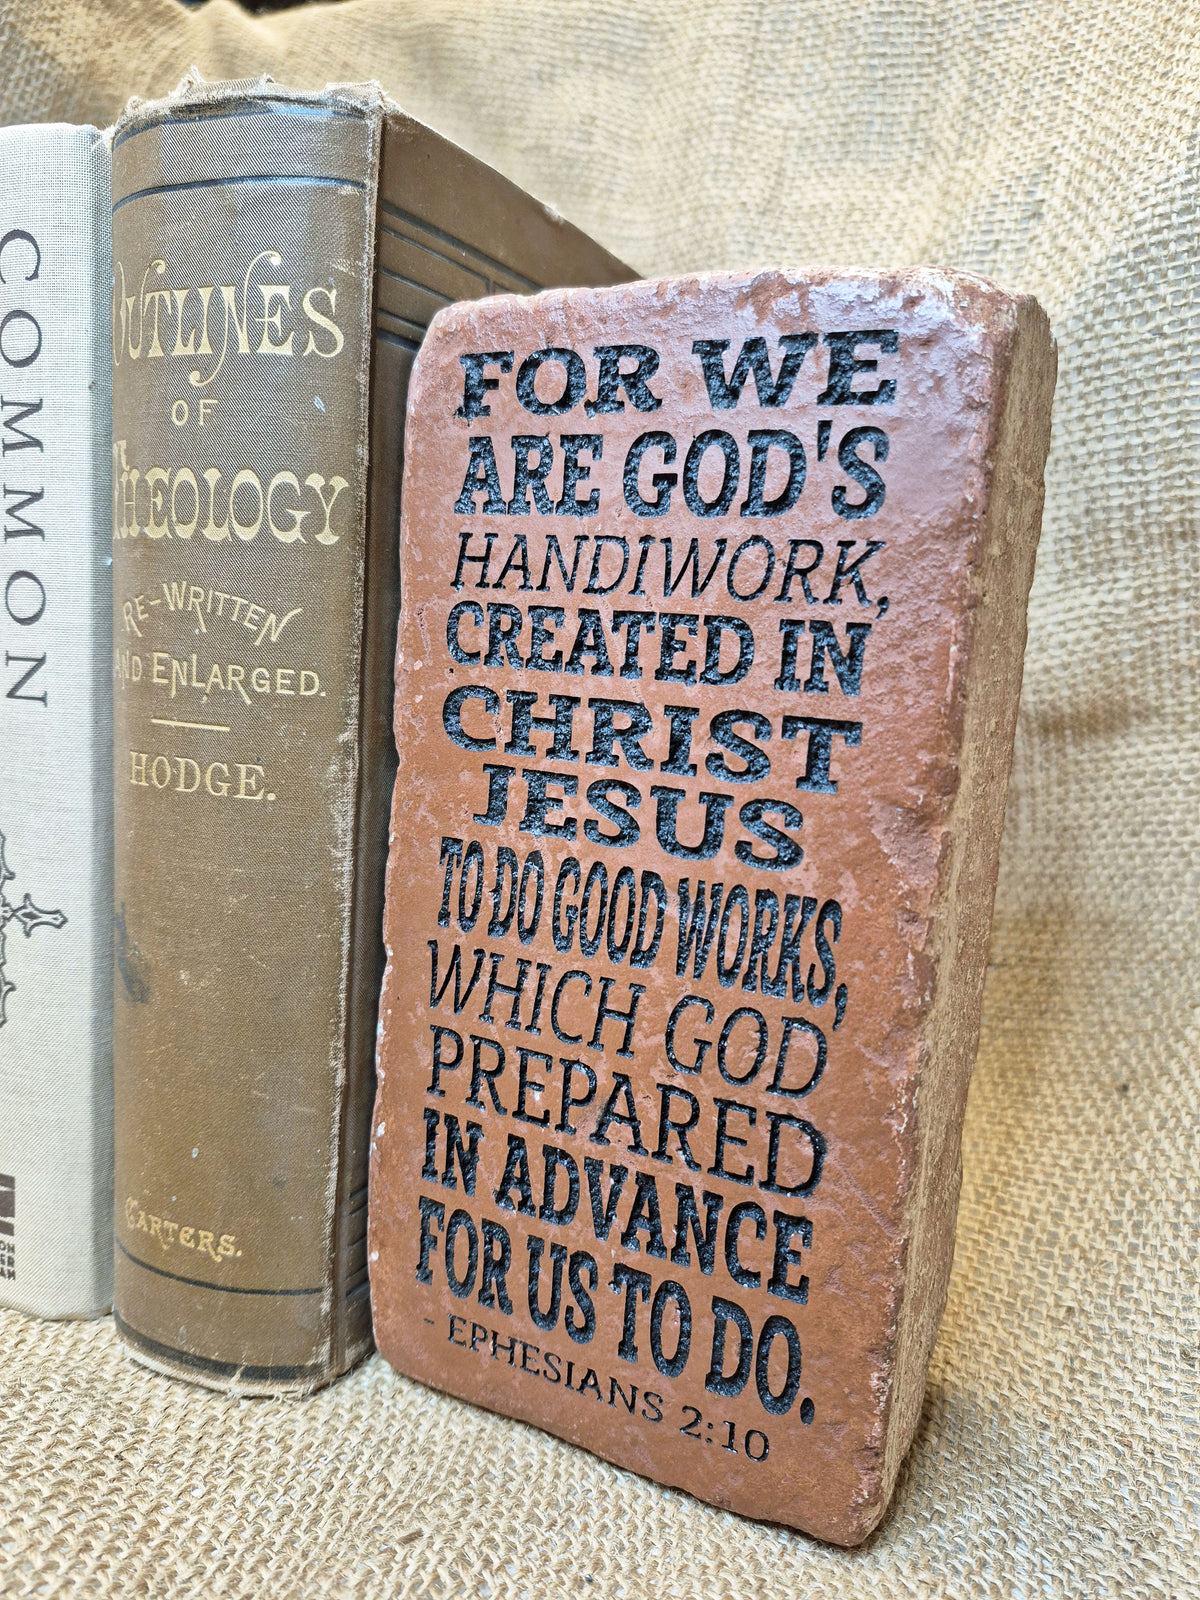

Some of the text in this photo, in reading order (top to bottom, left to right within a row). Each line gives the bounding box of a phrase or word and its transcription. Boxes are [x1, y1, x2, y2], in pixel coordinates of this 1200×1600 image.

[172, 399, 218, 426] OF
[455, 329, 899, 424] FOR WE
[0, 228, 48, 709] COMMON
[453, 419, 890, 521] ARE GOD'S
[121, 581, 302, 647] RE-WRITTEN
[450, 532, 890, 619] HANDIWORK,
[152, 651, 326, 705] ENLARGED.
[446, 600, 872, 697] CREATED IN
[129, 751, 276, 801] HODGE.
[442, 685, 863, 794] CHRIST
[472, 763, 805, 872] JESUS
[437, 836, 848, 1032] TO DO GOOD WORKS,
[426, 939, 828, 1099] WHICH GOD
[426, 1024, 828, 1199] PREPARED
[124, 1196, 243, 1263] CARTERS.
[421, 1106, 814, 1305] IN ADVANCE
[415, 1194, 815, 1426] FOR US TO DO.
[446, 1313, 664, 1424] EPHESIANS
[679, 1405, 770, 1463] 2:10
